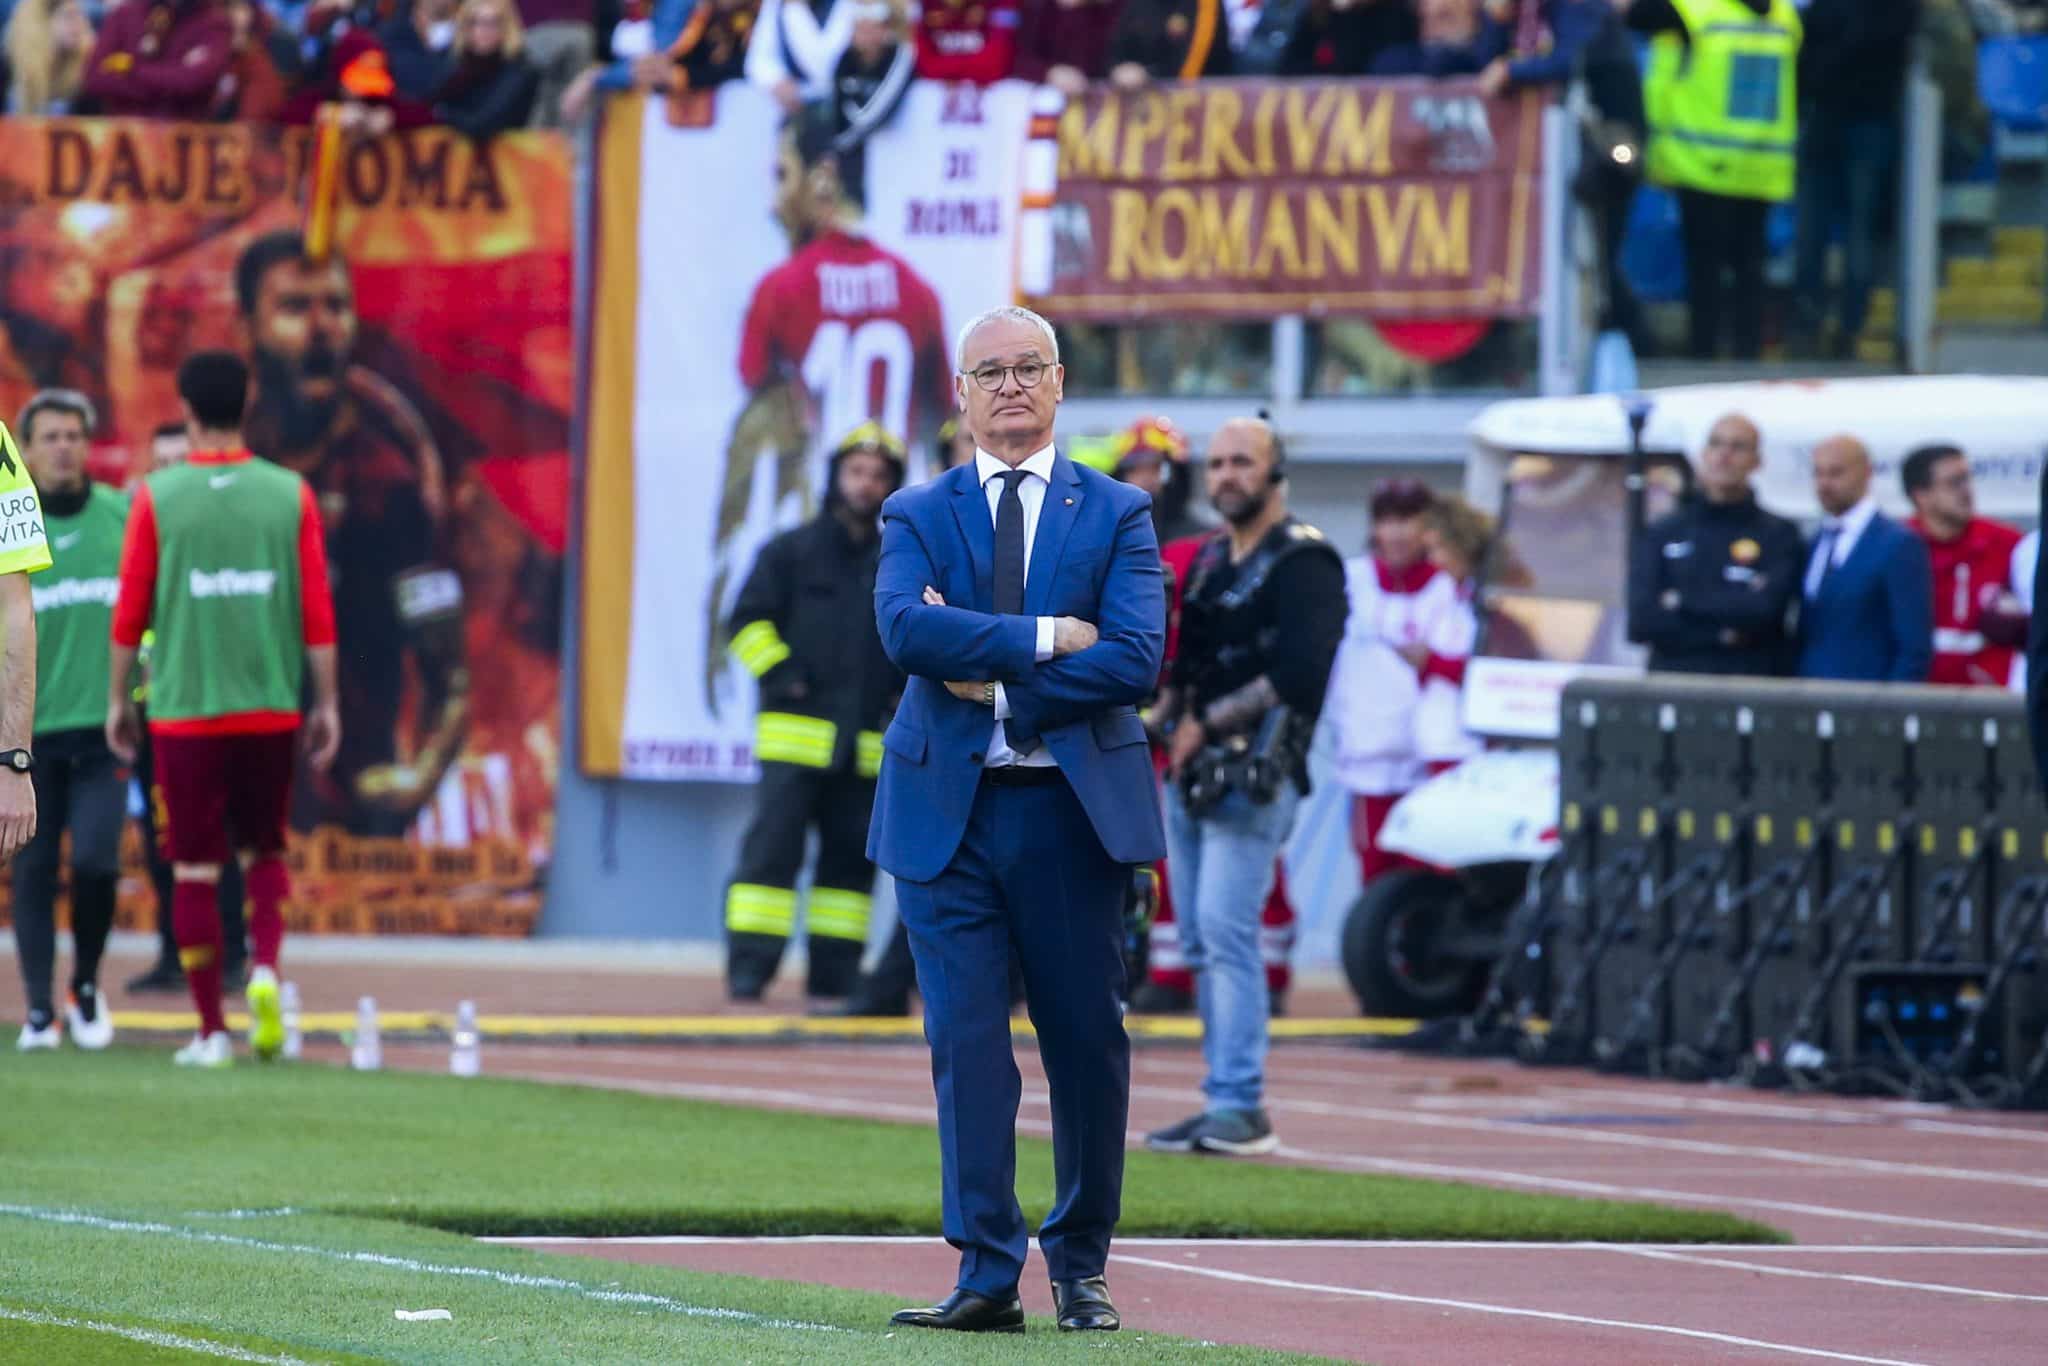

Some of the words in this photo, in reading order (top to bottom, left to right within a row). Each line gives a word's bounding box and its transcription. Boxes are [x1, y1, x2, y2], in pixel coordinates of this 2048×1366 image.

[47, 128, 243, 201] DAJE
[1057, 87, 1394, 181] MPERIVM
[1107, 186, 1471, 280] ROMANVM
[802, 319, 915, 450] 10
